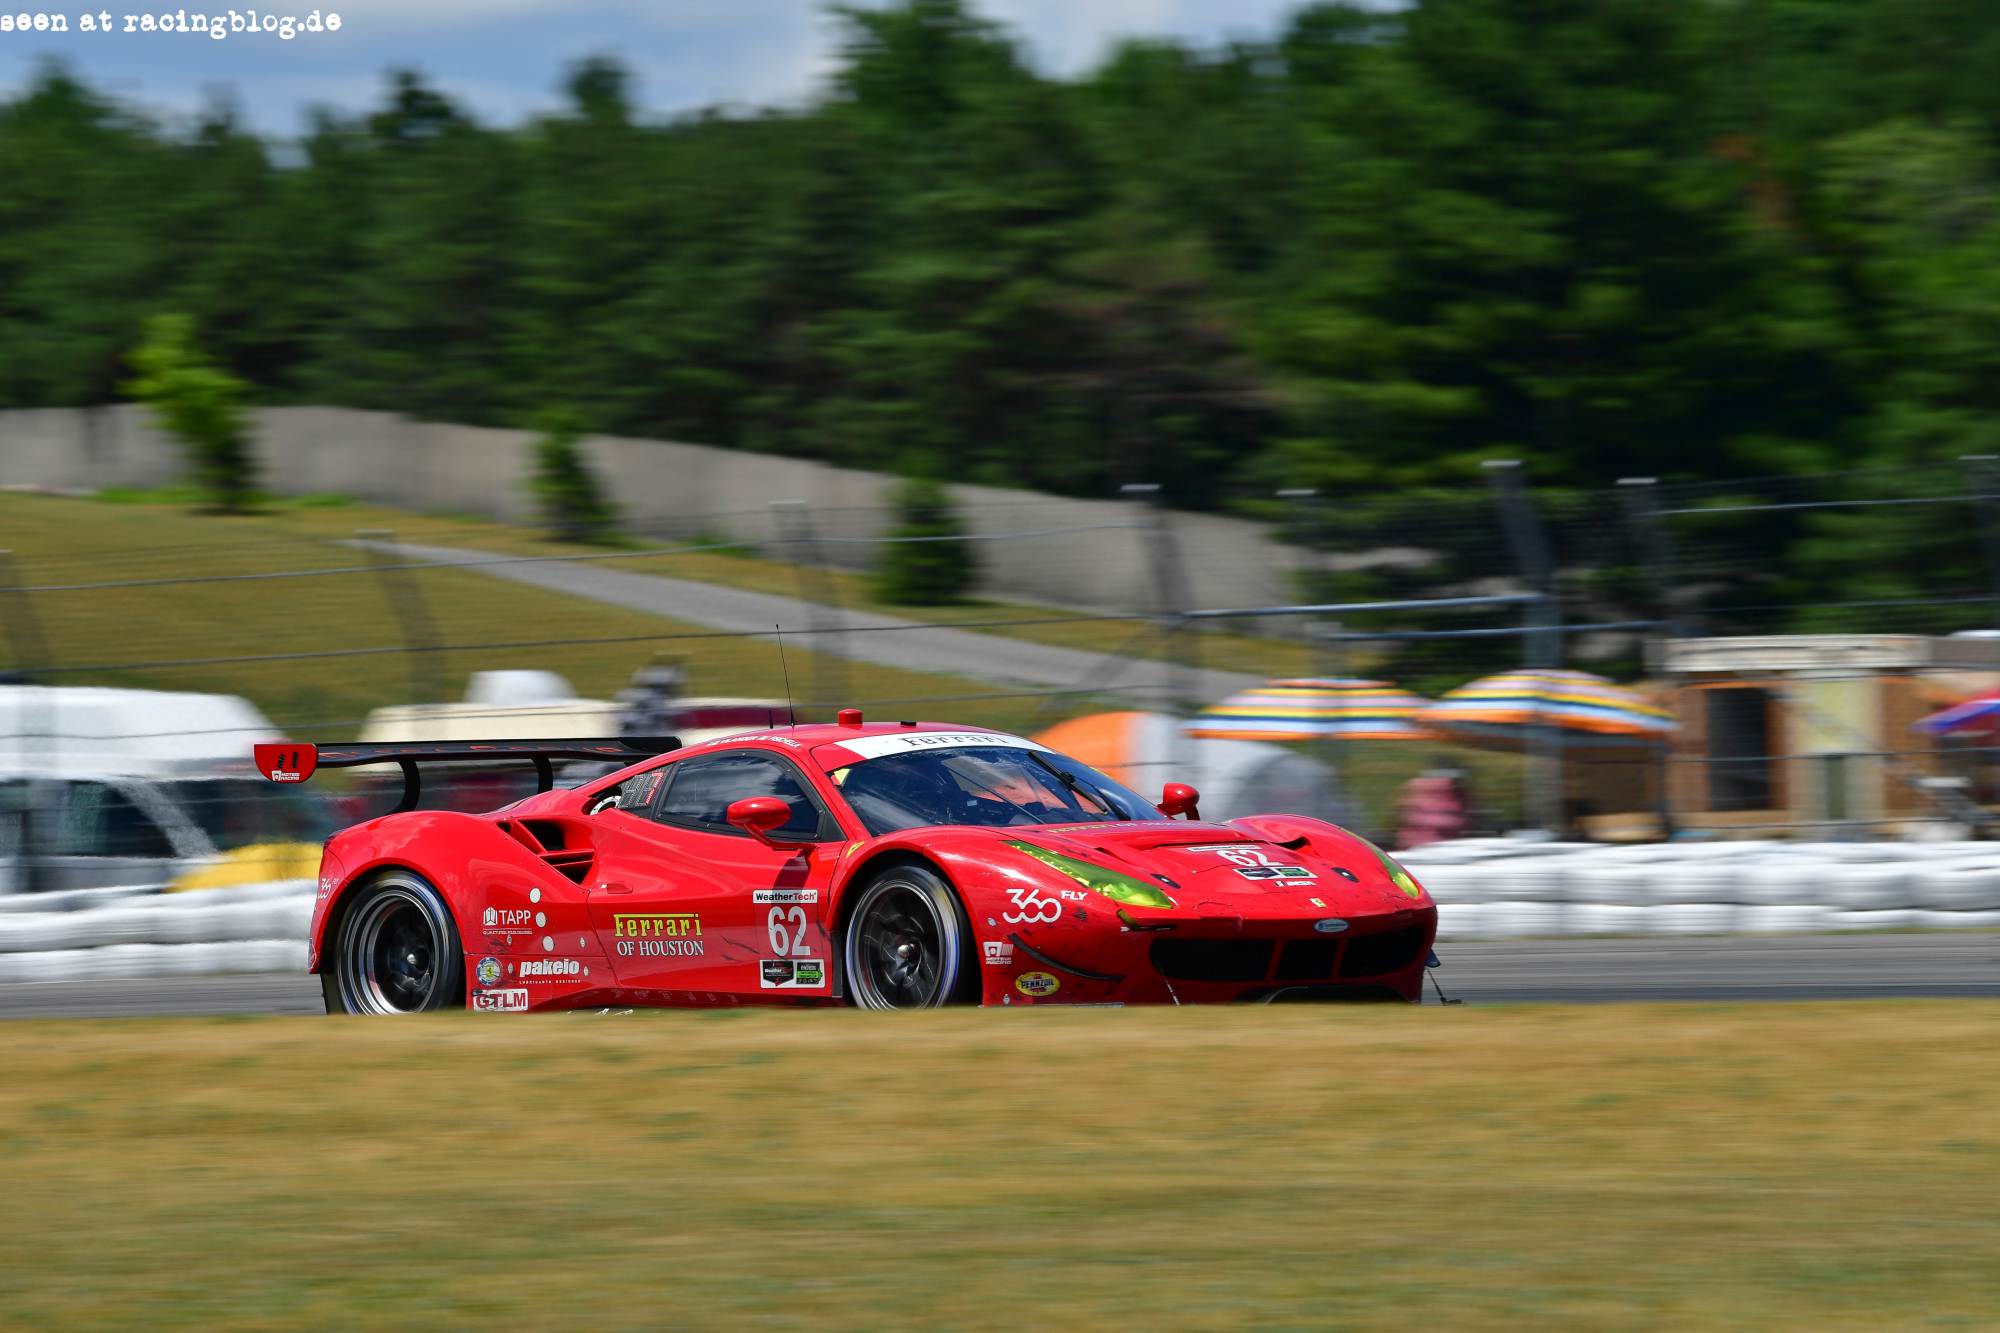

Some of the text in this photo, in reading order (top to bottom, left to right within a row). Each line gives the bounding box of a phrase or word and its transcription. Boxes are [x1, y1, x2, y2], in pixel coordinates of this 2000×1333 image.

[898, 734, 1009, 747] Ferrari
[1217, 849, 1284, 867] 62
[755, 891, 817, 901] WeatherTech
[1002, 888, 1089, 924] 360 FLY
[498, 909, 532, 925] TAPP
[613, 913, 703, 938] Ferrari
[767, 905, 811, 957] 62
[616, 940, 704, 956] OF HOUSTON
[475, 992, 527, 1009] GTLM
